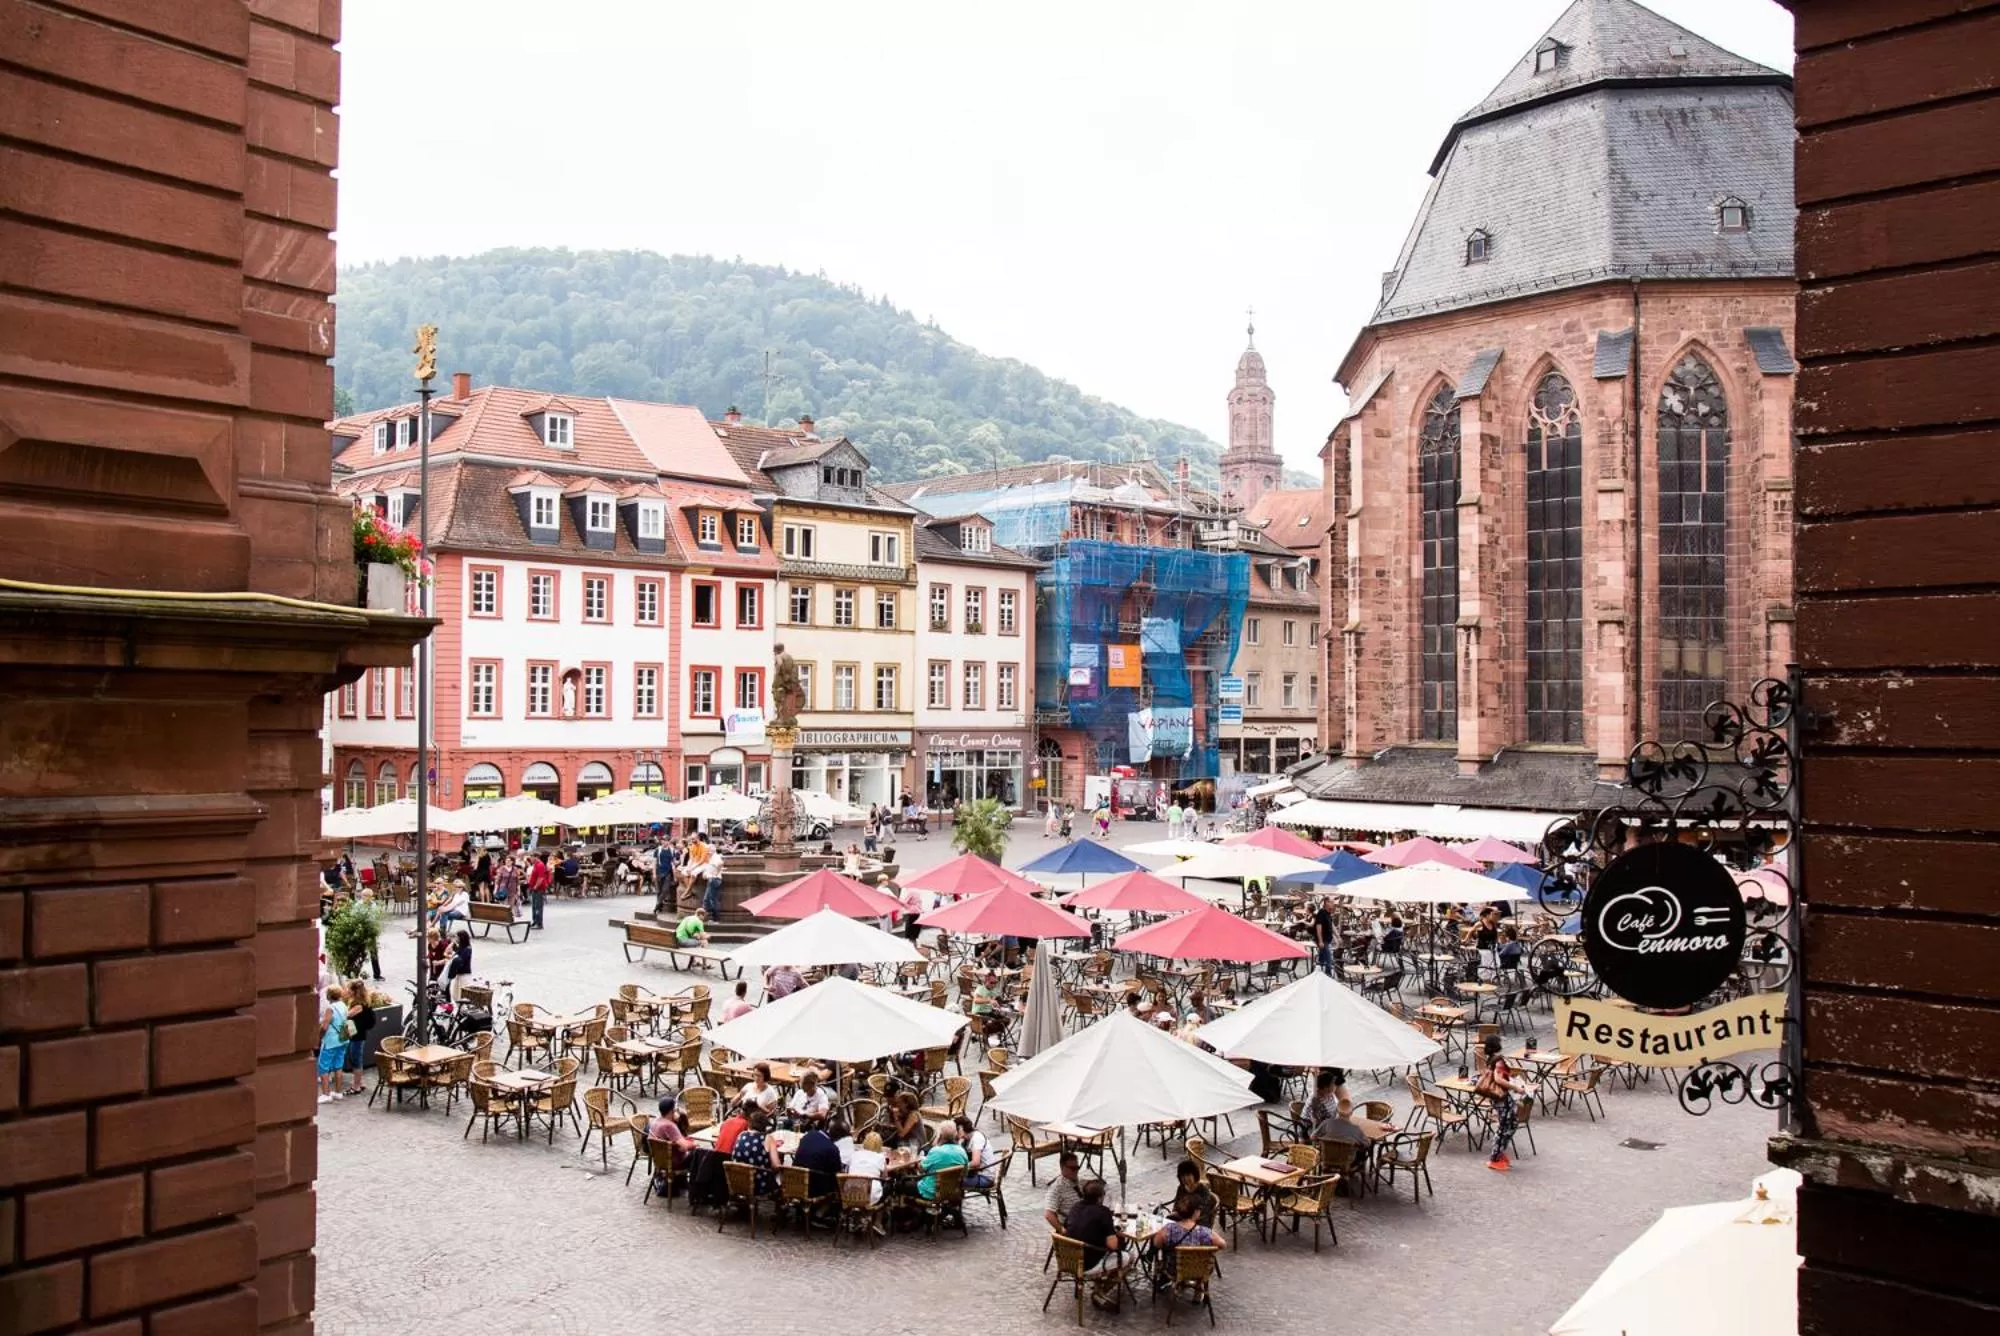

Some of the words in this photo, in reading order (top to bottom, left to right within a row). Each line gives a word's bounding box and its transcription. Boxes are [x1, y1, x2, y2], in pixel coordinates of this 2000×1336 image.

[794, 732, 899, 744] BIBLIOGRAPHICUM
[929, 733, 958, 746] Classic
[959, 733, 989, 747] Country
[1617, 912, 1655, 933] Café
[1566, 1009, 1772, 1055] Restaurant
